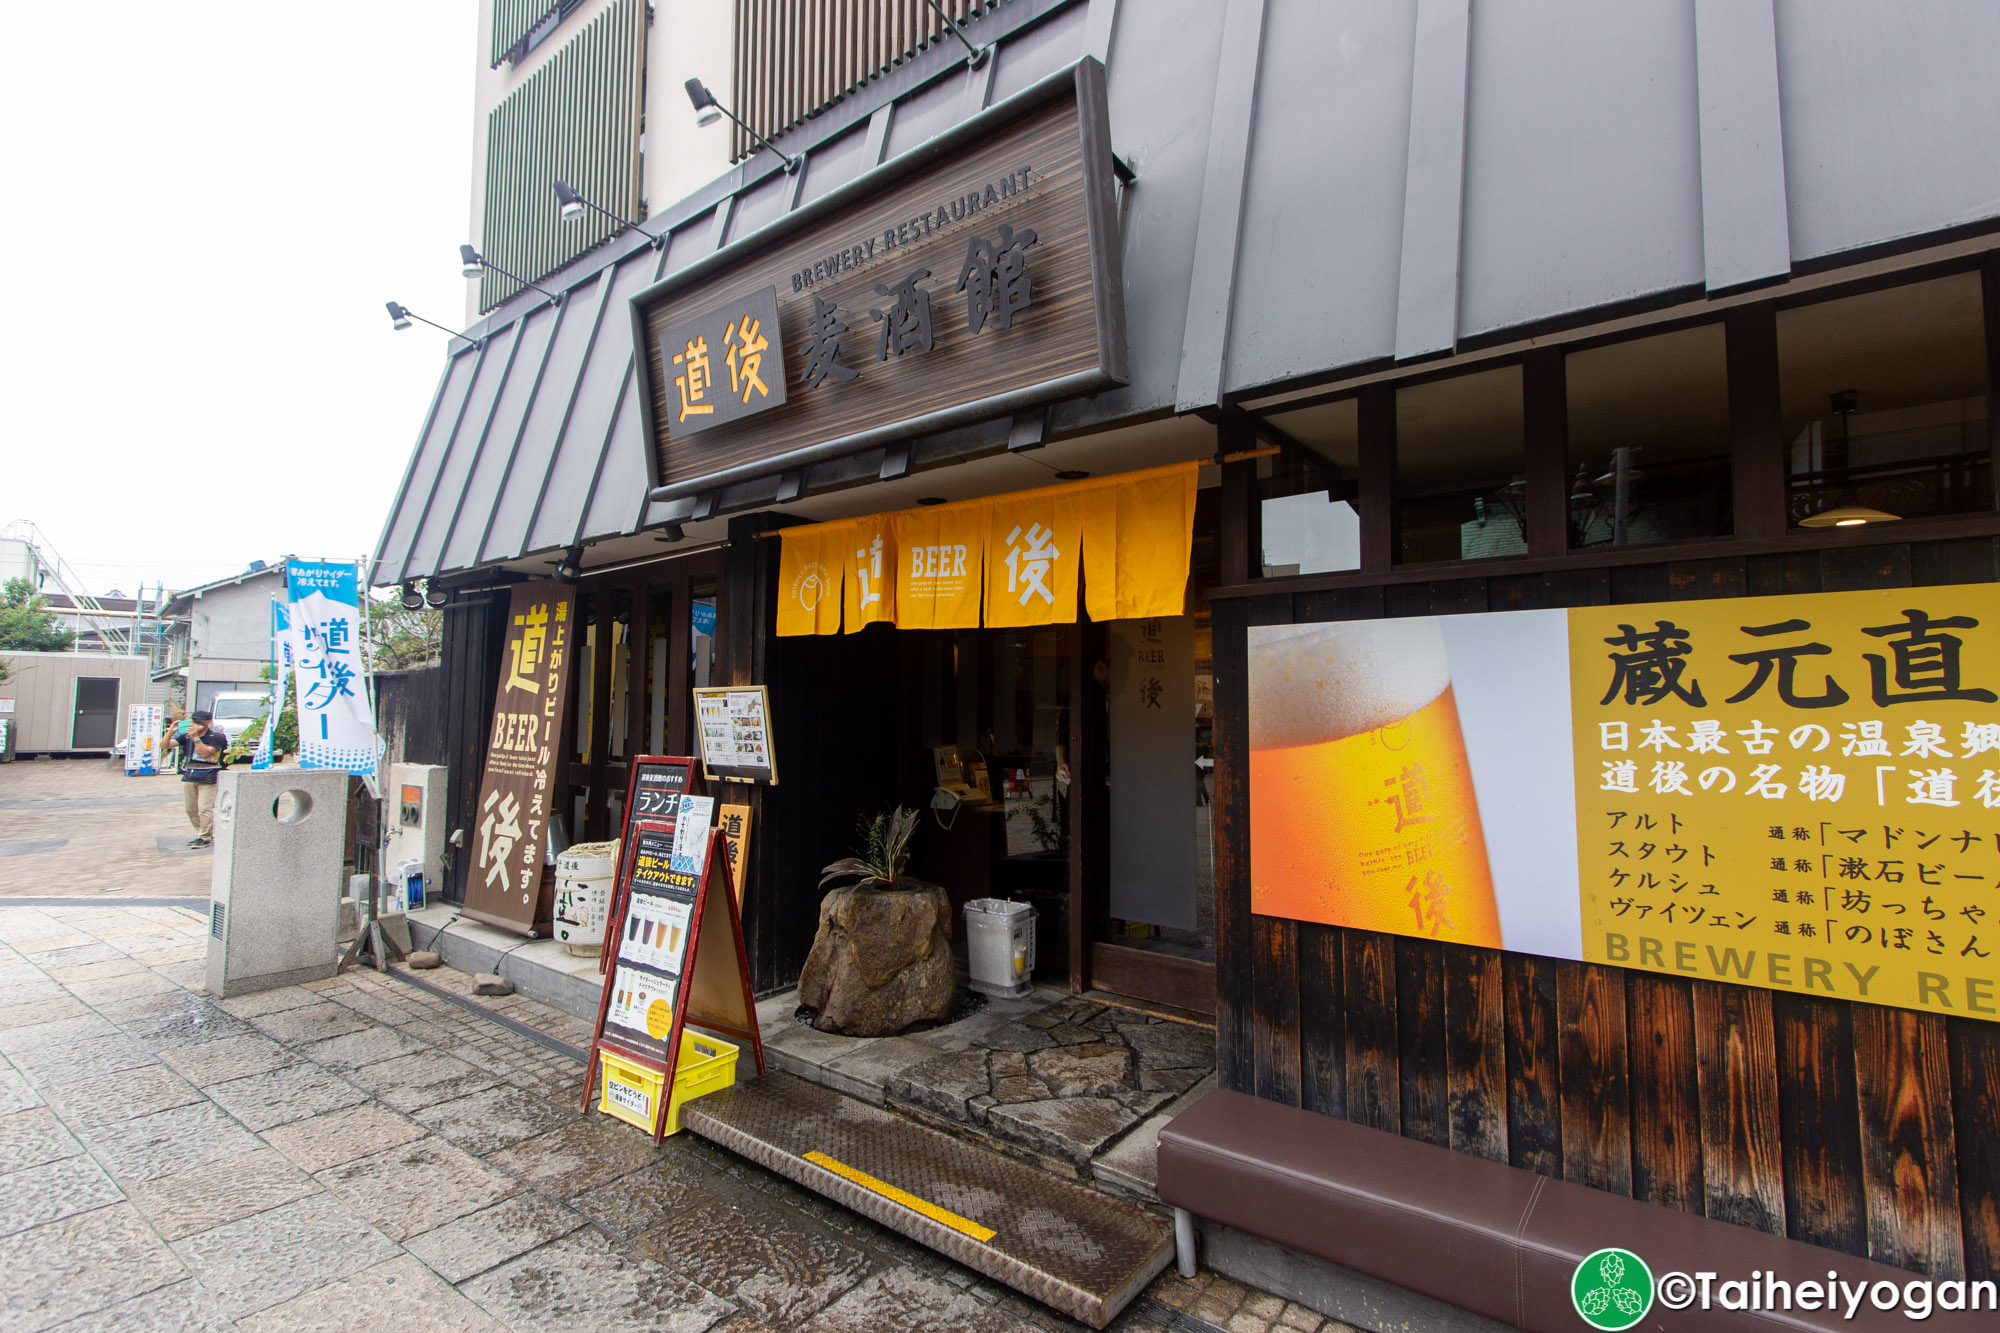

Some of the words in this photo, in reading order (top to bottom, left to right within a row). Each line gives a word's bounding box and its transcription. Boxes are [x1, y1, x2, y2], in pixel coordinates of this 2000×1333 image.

[790, 237, 876, 293] BREWERY
[885, 165, 1032, 250] RESTAURANT
[671, 314, 769, 424] 道後
[800, 224, 1040, 391] 麦酒館
[911, 544, 967, 579] BEER
[1005, 522, 1060, 606] 後
[320, 617, 356, 697] 道後
[504, 602, 549, 695] 道
[1600, 609, 1999, 709] 蔵元直
[492, 712, 539, 753] BEER
[518, 600, 569, 906] 湯上がりビール冷えてます。
[640, 791, 678, 814] ランチ
[1383, 760, 1436, 834] 道
[1606, 810, 1684, 835] アルト
[1768, 821, 2000, 855] 通称「マドンナ
[479, 789, 523, 892] 後
[1607, 840, 1716, 868] スタウト
[1770, 854, 2000, 890] 通称「漱石ビー
[1405, 869, 1457, 937] 後
[1608, 867, 1720, 897] ケルシュ
[1772, 886, 2000, 926] 通称「坊っちゃ
[1609, 896, 1758, 932] ヴァイツェン
[1773, 919, 1991, 958] 通称「のぼさん
[1605, 932, 1881, 996] BREWERY
[1917, 971, 1997, 1014] RE
